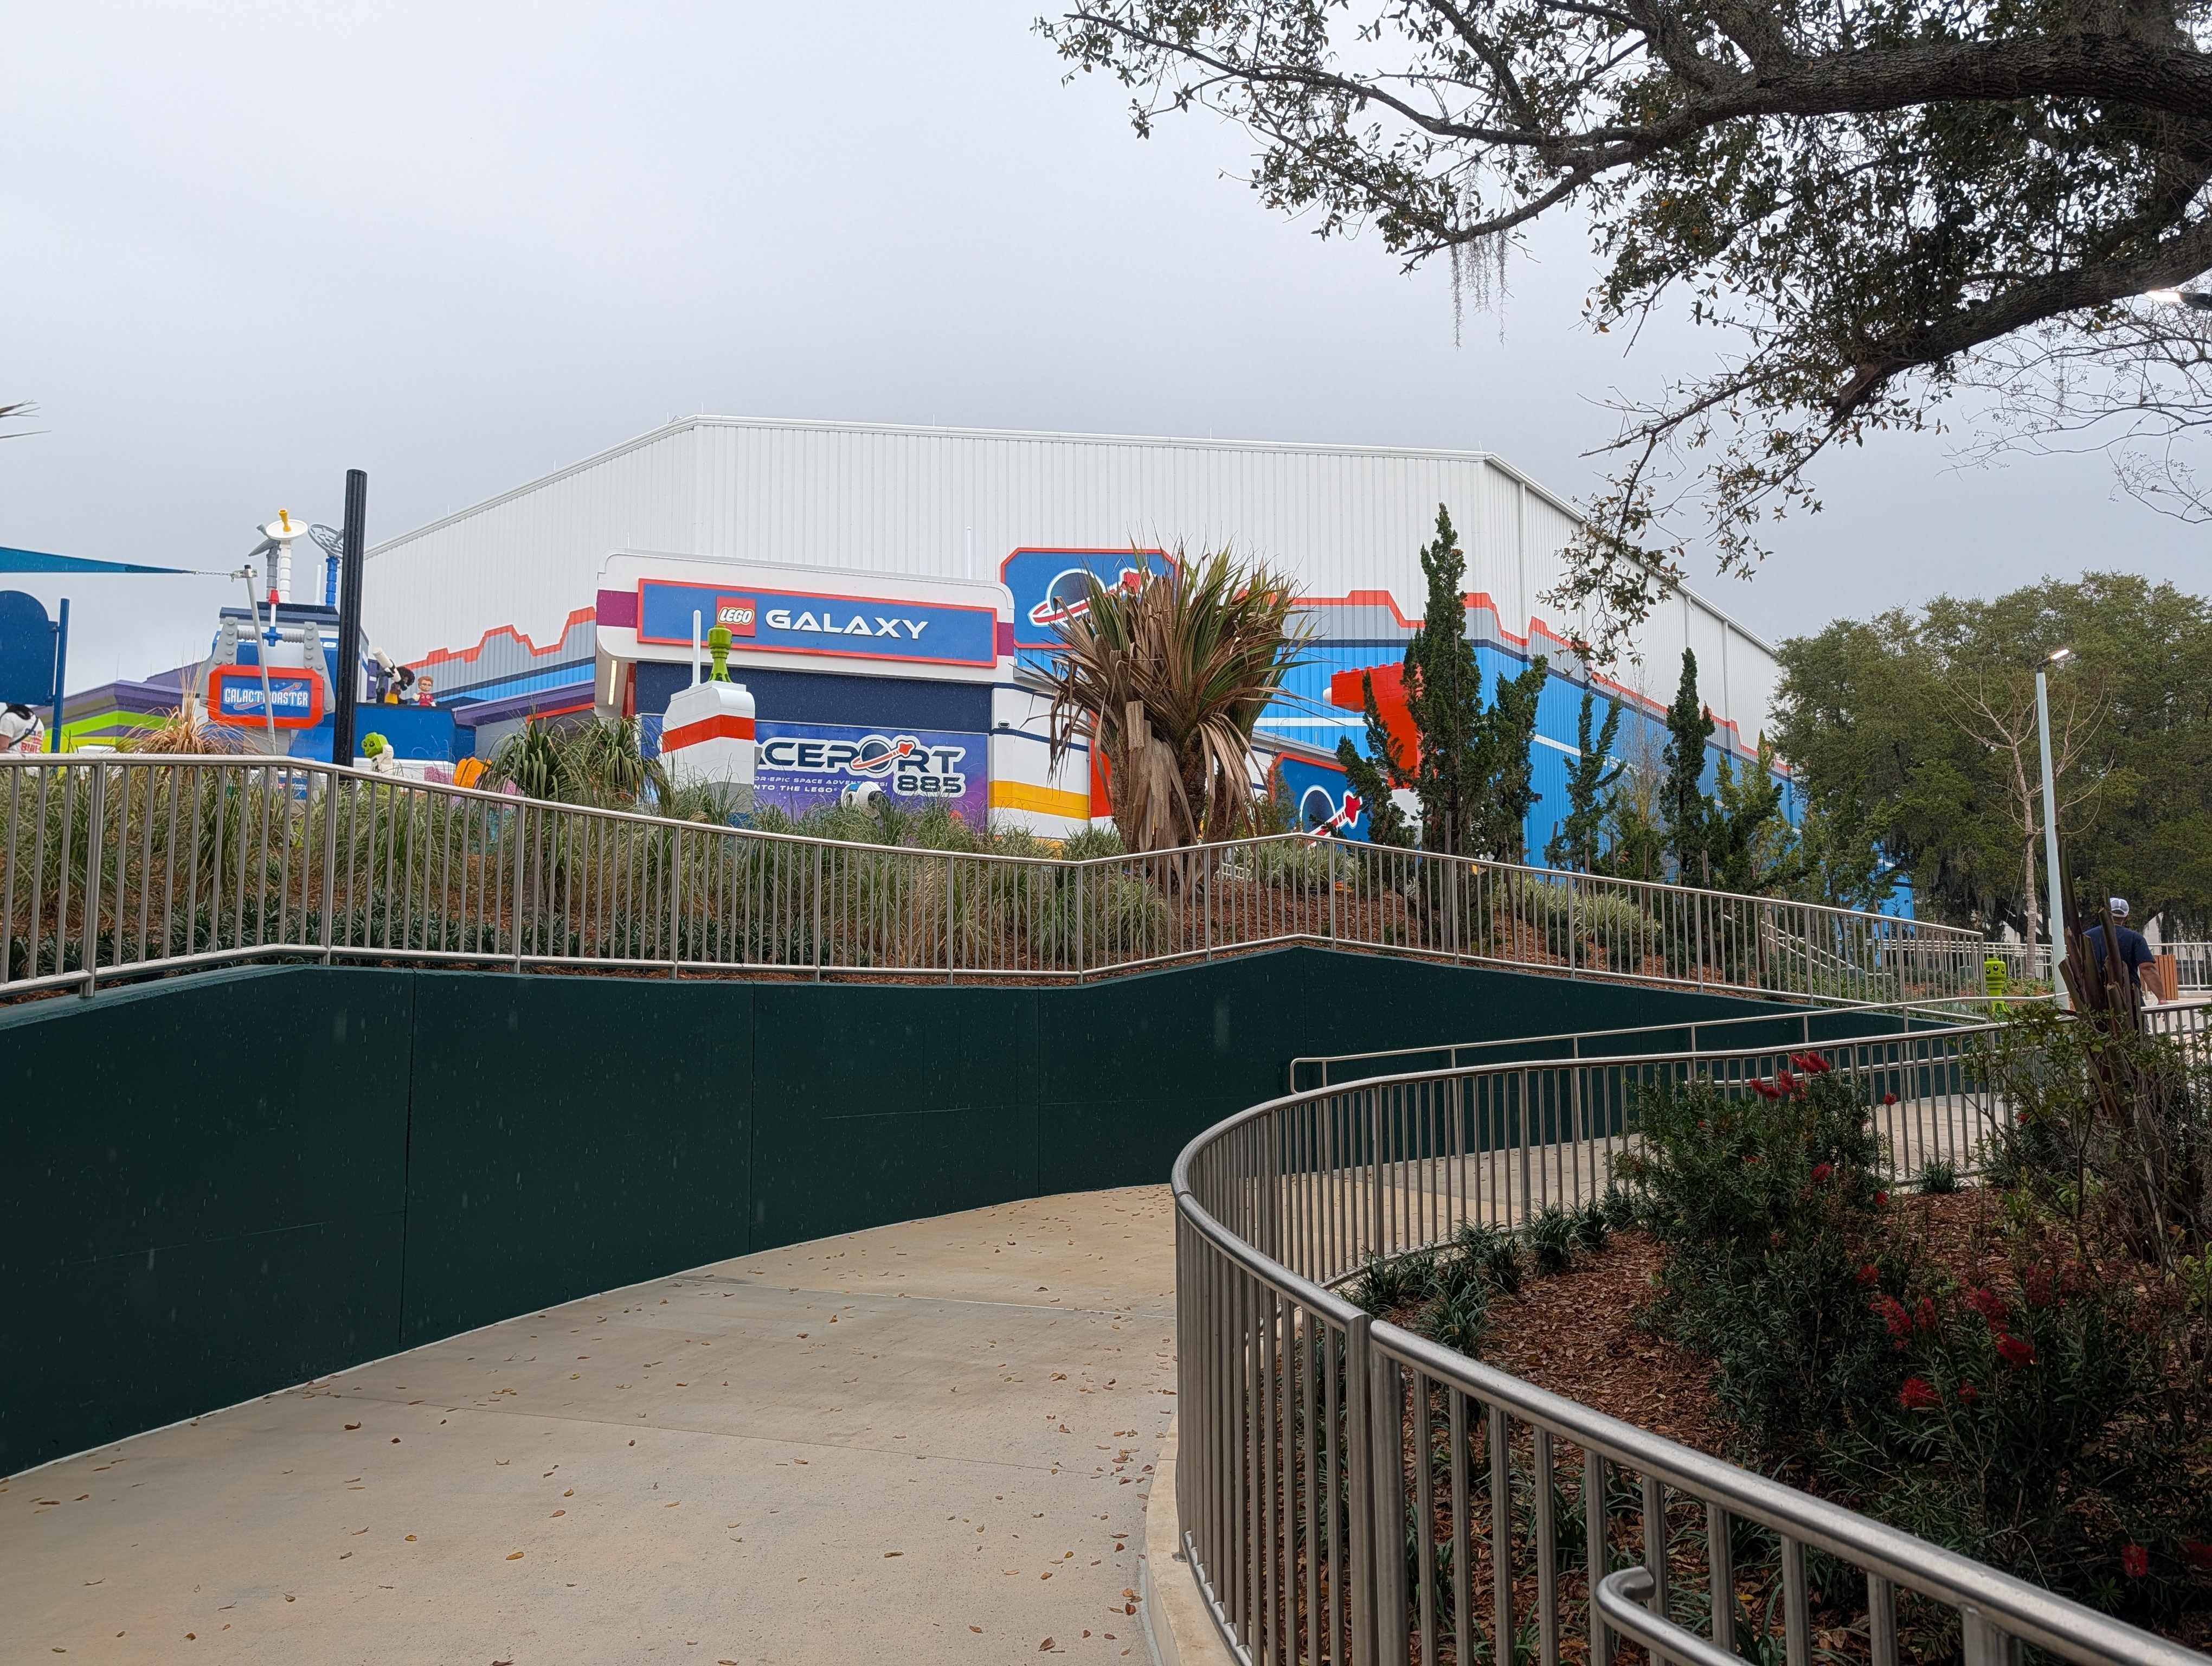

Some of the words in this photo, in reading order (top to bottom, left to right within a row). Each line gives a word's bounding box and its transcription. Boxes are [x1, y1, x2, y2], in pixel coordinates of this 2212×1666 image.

[718, 608, 754, 624] LEGO
[766, 610, 929, 640] GALAXY
[224, 688, 309, 707] GALACTOASTER
[758, 739, 962, 774] CEPORT
[897, 775, 961, 793] 885
